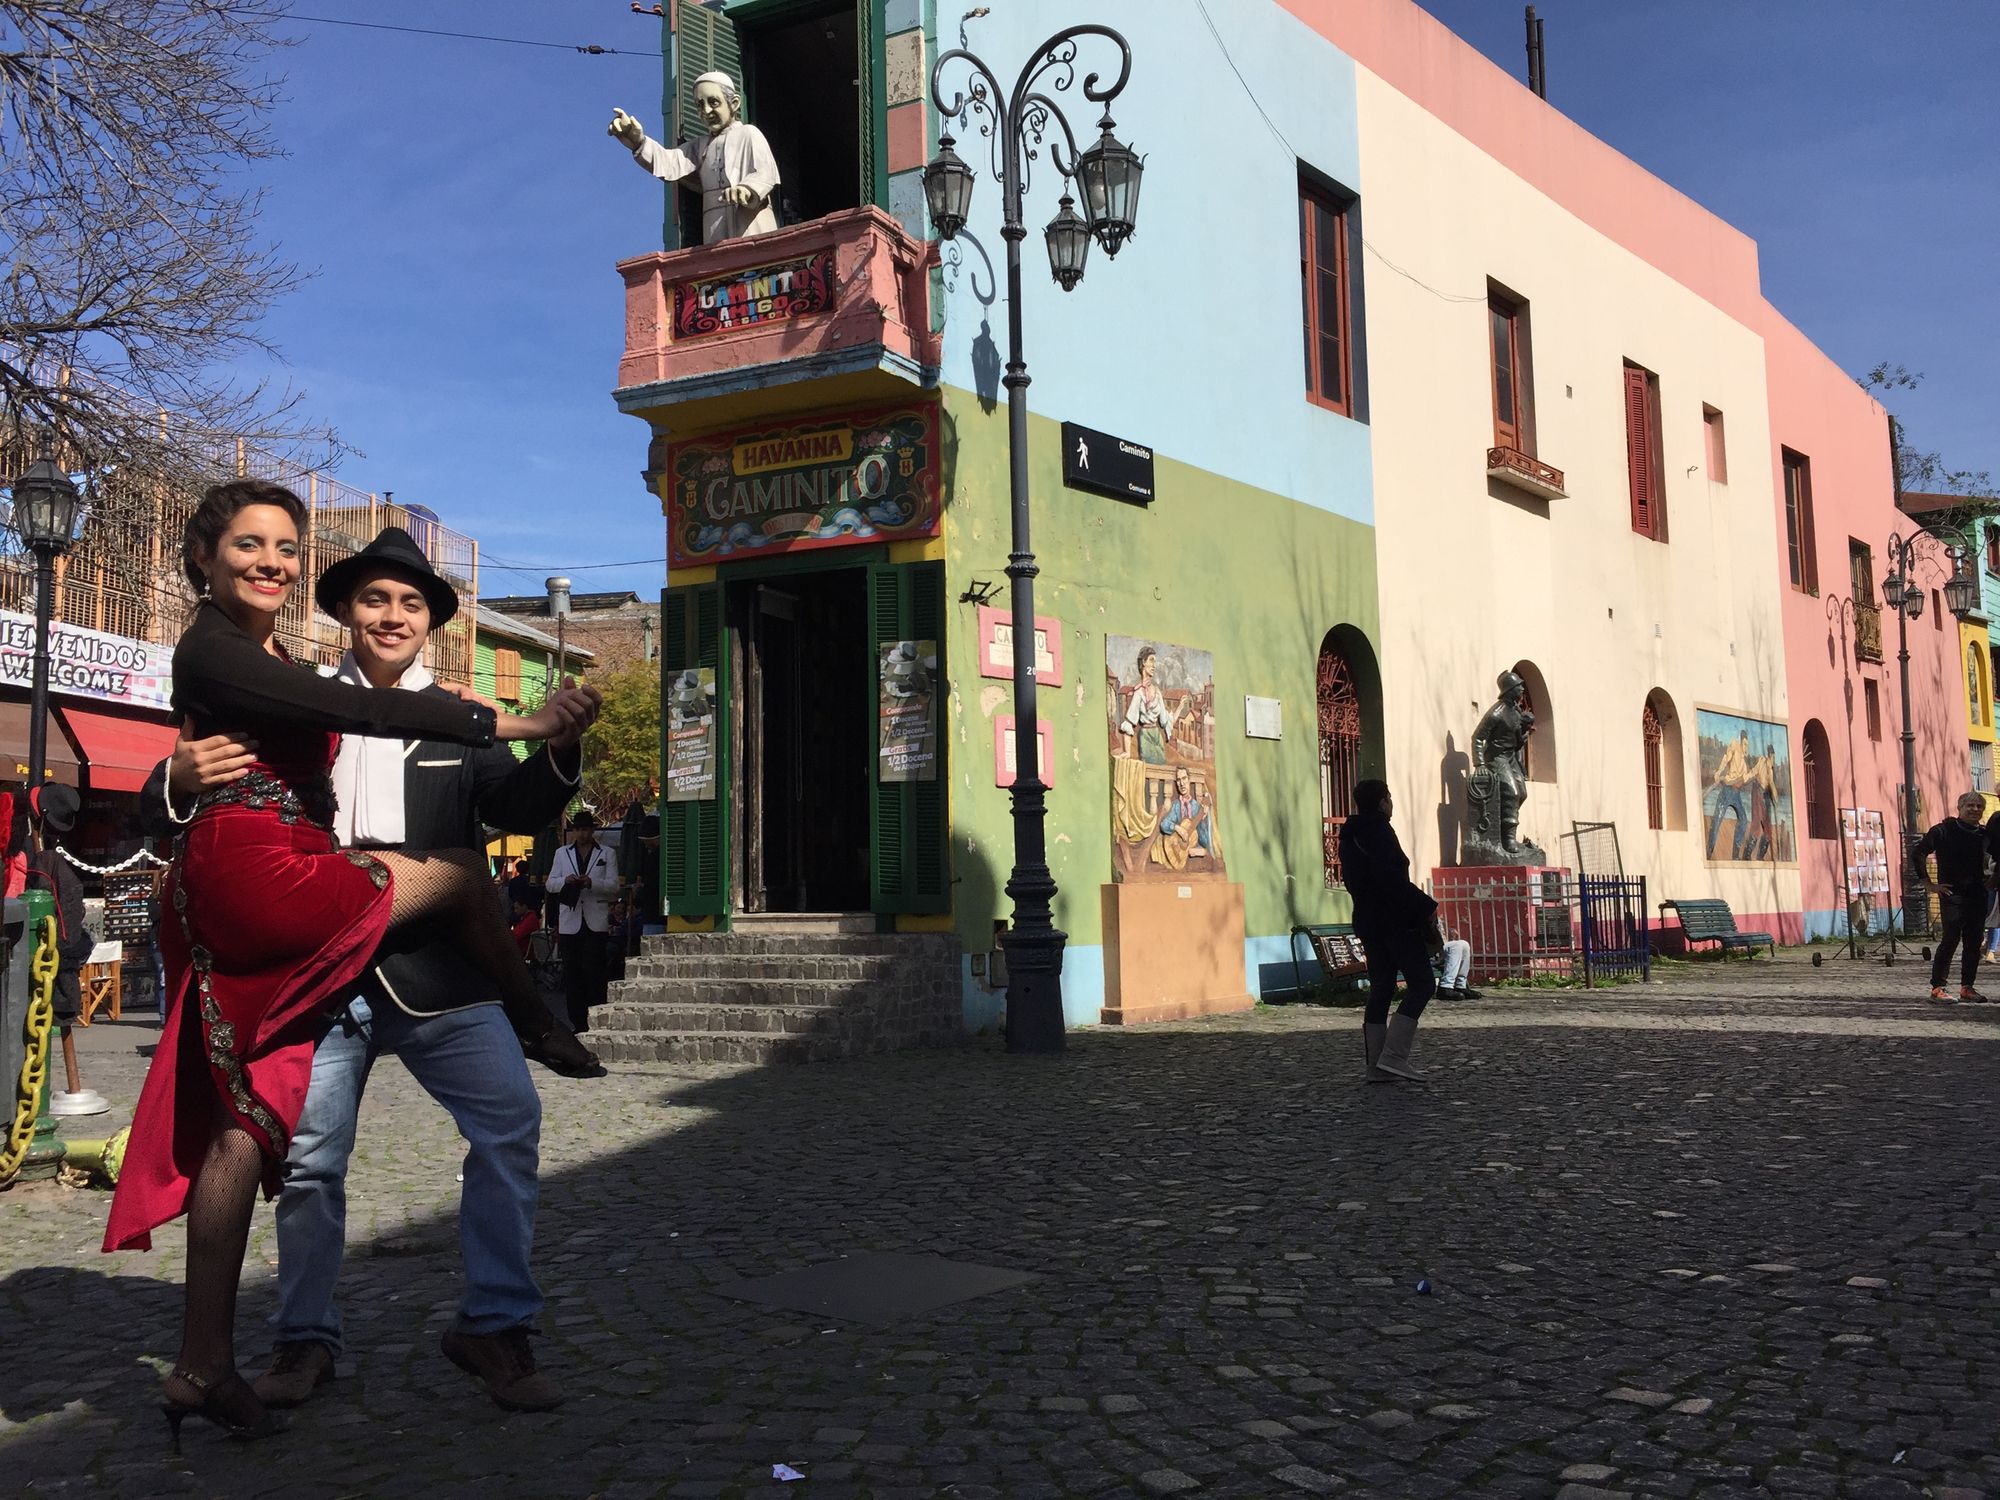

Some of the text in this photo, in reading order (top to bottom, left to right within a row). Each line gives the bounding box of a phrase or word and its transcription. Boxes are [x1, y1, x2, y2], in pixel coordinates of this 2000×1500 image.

[700, 270, 809, 309] CAMINITO
[720, 296, 788, 322] AMIGO
[743, 434, 843, 469] HAVANNA
[1119, 441, 1150, 460] Caminito
[704, 454, 891, 521] CAMINITO
[1128, 483, 1147, 495] Comuna
[889, 746, 912, 754] Gratis
[888, 753, 934, 767] 1/2 Docena
[674, 774, 712, 789] 1/2 Docena
